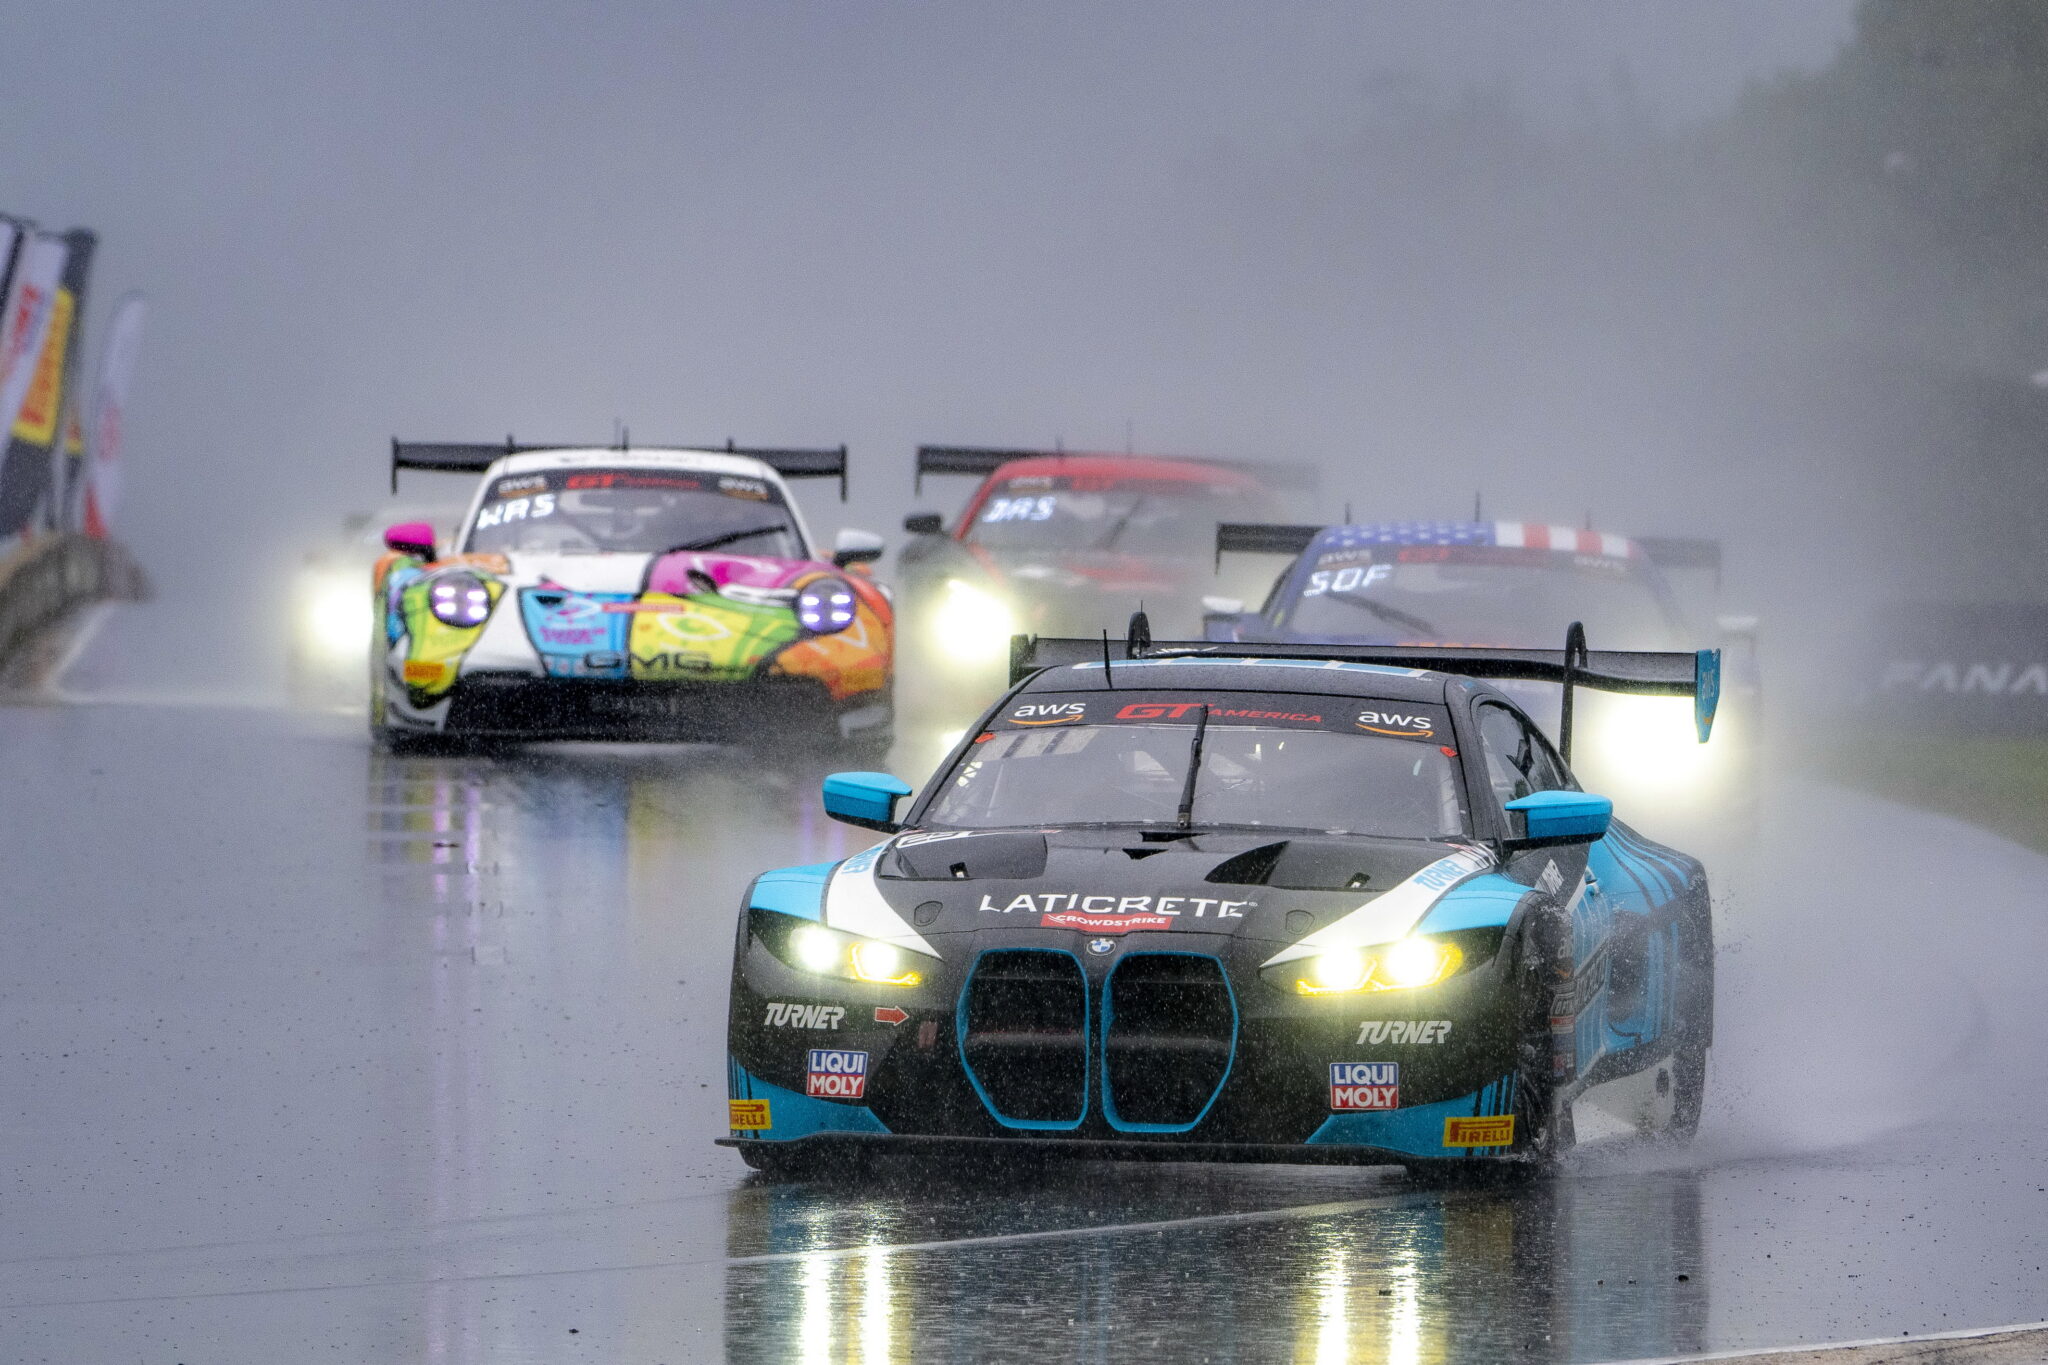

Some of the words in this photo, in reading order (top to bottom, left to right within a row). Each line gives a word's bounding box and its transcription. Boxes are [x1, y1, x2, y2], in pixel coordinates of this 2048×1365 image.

[1303, 563, 1393, 598] SOF
[1014, 702, 1086, 717] aws
[1115, 703, 1204, 719] GT
[1207, 708, 1322, 723] AMERICA
[1358, 711, 1431, 729] aws
[1050, 914, 1166, 927] CROWDSTRIKE
[764, 1003, 846, 1030] TURNER
[1356, 1020, 1452, 1045] TURNER
[811, 1052, 865, 1074] LIQUI
[809, 1075, 863, 1095] MOLY
[1333, 1065, 1395, 1086] LIQUI
[1334, 1087, 1397, 1107] MOLY
[1450, 1120, 1511, 1143] PIRELLI
